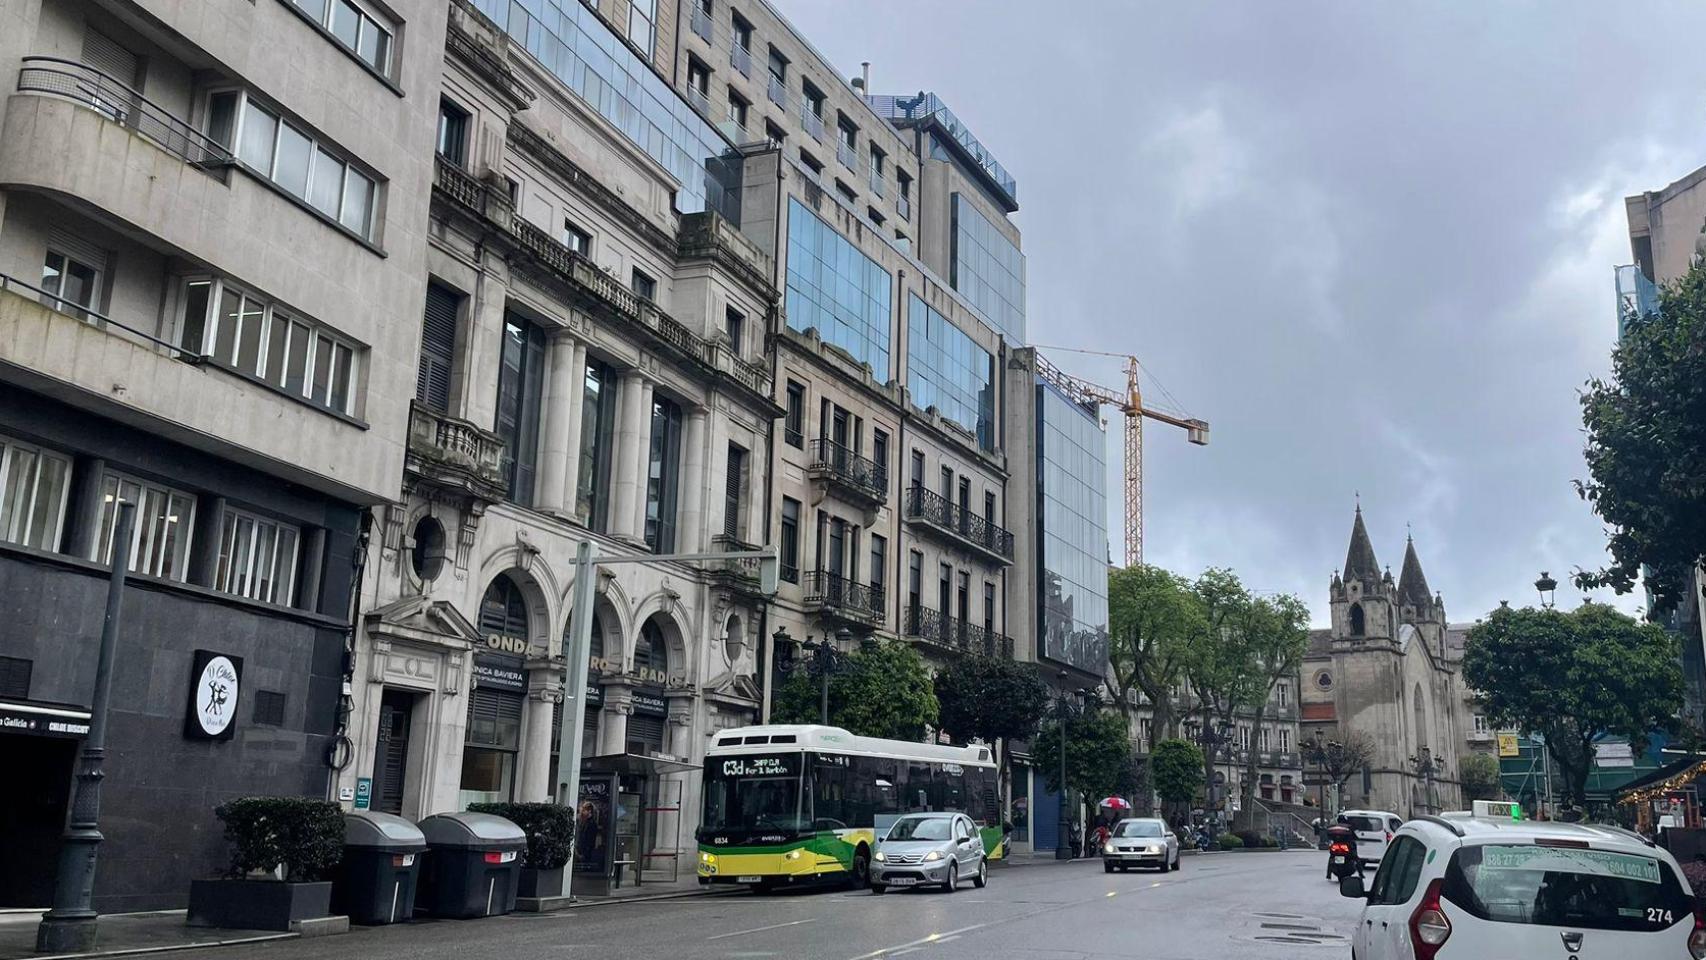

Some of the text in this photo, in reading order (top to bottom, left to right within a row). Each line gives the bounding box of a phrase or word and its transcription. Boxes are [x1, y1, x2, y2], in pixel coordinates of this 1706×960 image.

[487, 633, 534, 656] ONDA
[590, 656, 609, 670] RO
[493, 669, 523, 681] BAVIERA
[640, 666, 680, 686] RADIO
[3, 716, 28, 729] Galicia
[723, 760, 744, 776] C3d
[714, 837, 728, 845] 6834
[1647, 907, 1674, 924] 274
